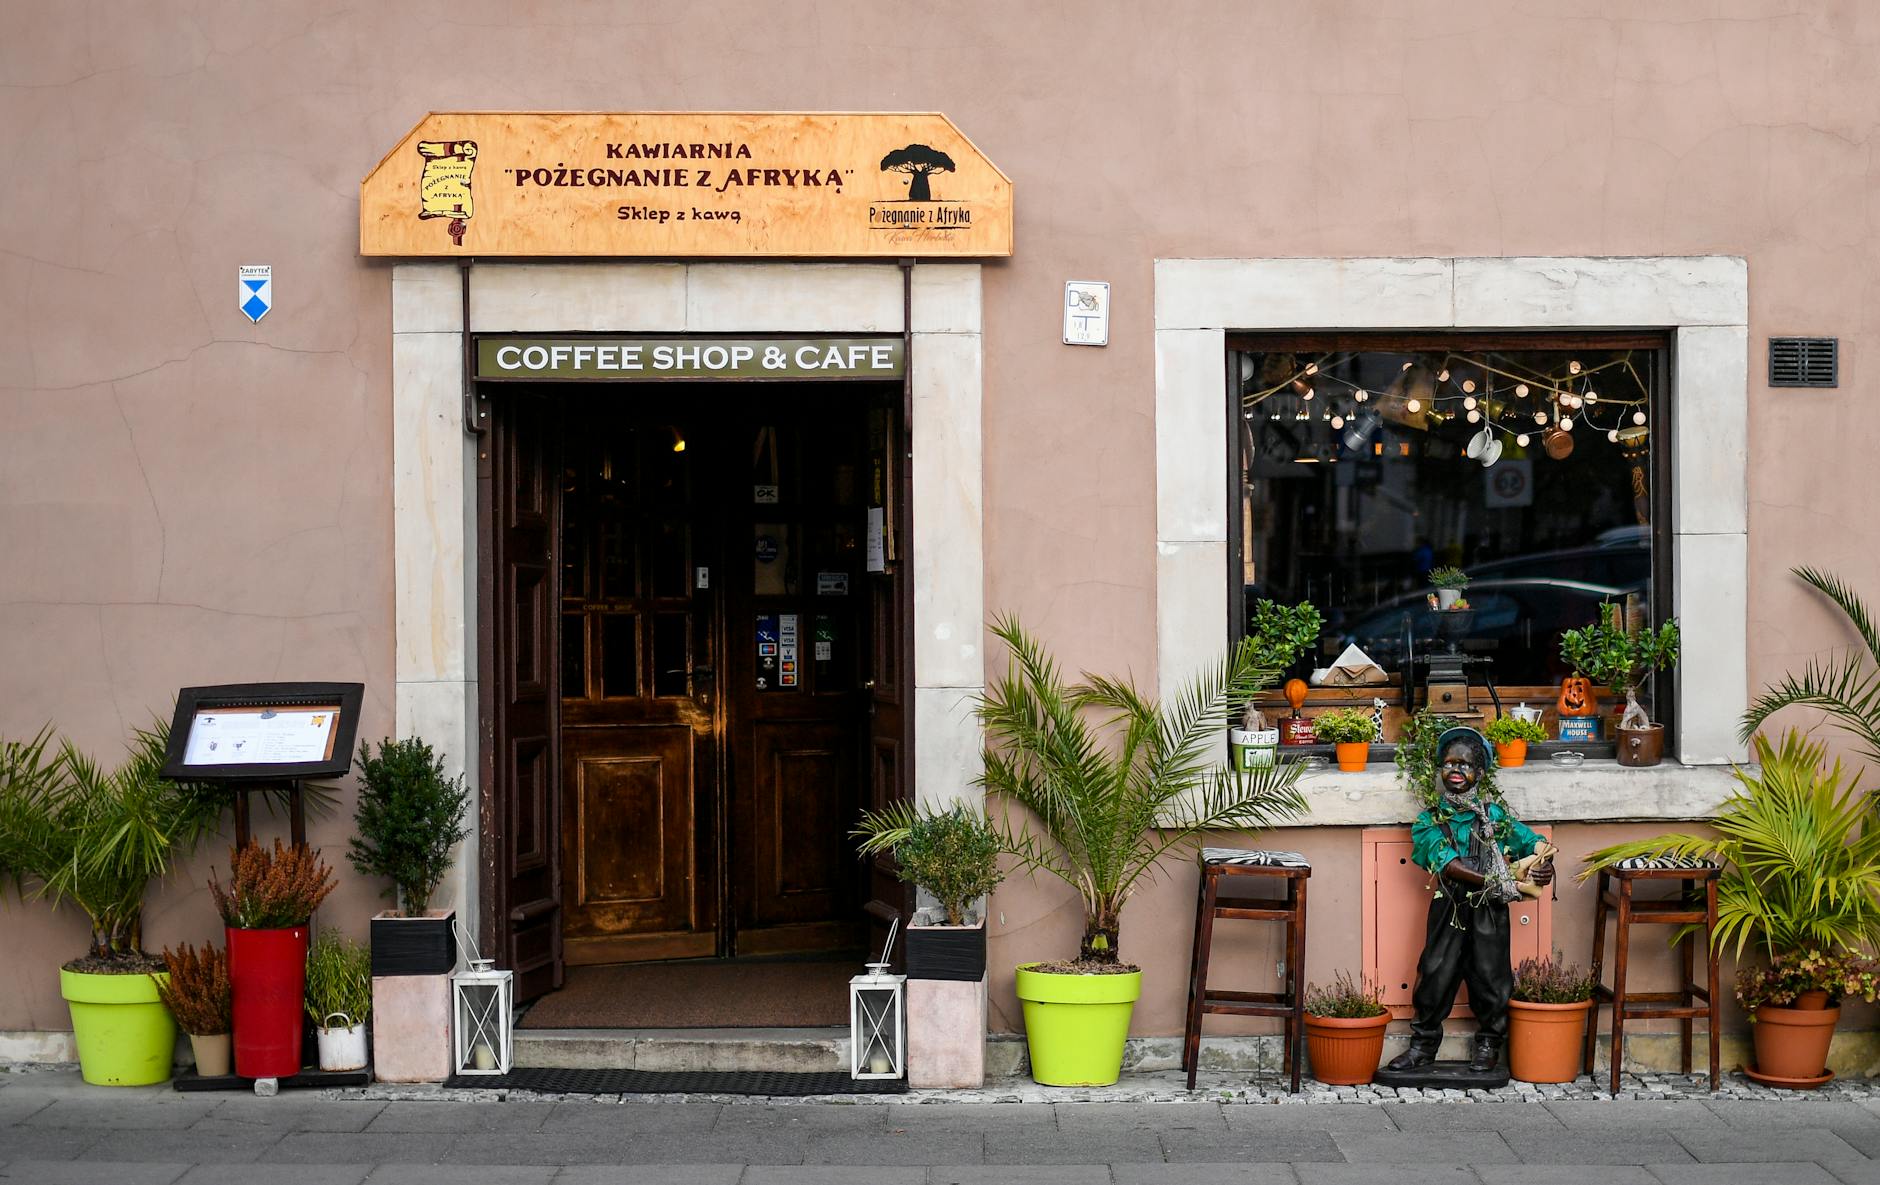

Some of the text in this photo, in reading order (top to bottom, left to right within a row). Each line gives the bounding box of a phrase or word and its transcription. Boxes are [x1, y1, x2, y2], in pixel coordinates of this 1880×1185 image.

[605, 143, 752, 159] KAWIARNIA
[504, 163, 689, 187] "POŻEGNANIE
[696, 169, 711, 187] Z
[617, 206, 742, 224] Sklep z kawą
[929, 210, 934, 223] z
[496, 345, 894, 370] COFFEE SHOP & CAFE
[1562, 720, 1593, 729] MAXWELL
[1241, 733, 1276, 744] APPLE
